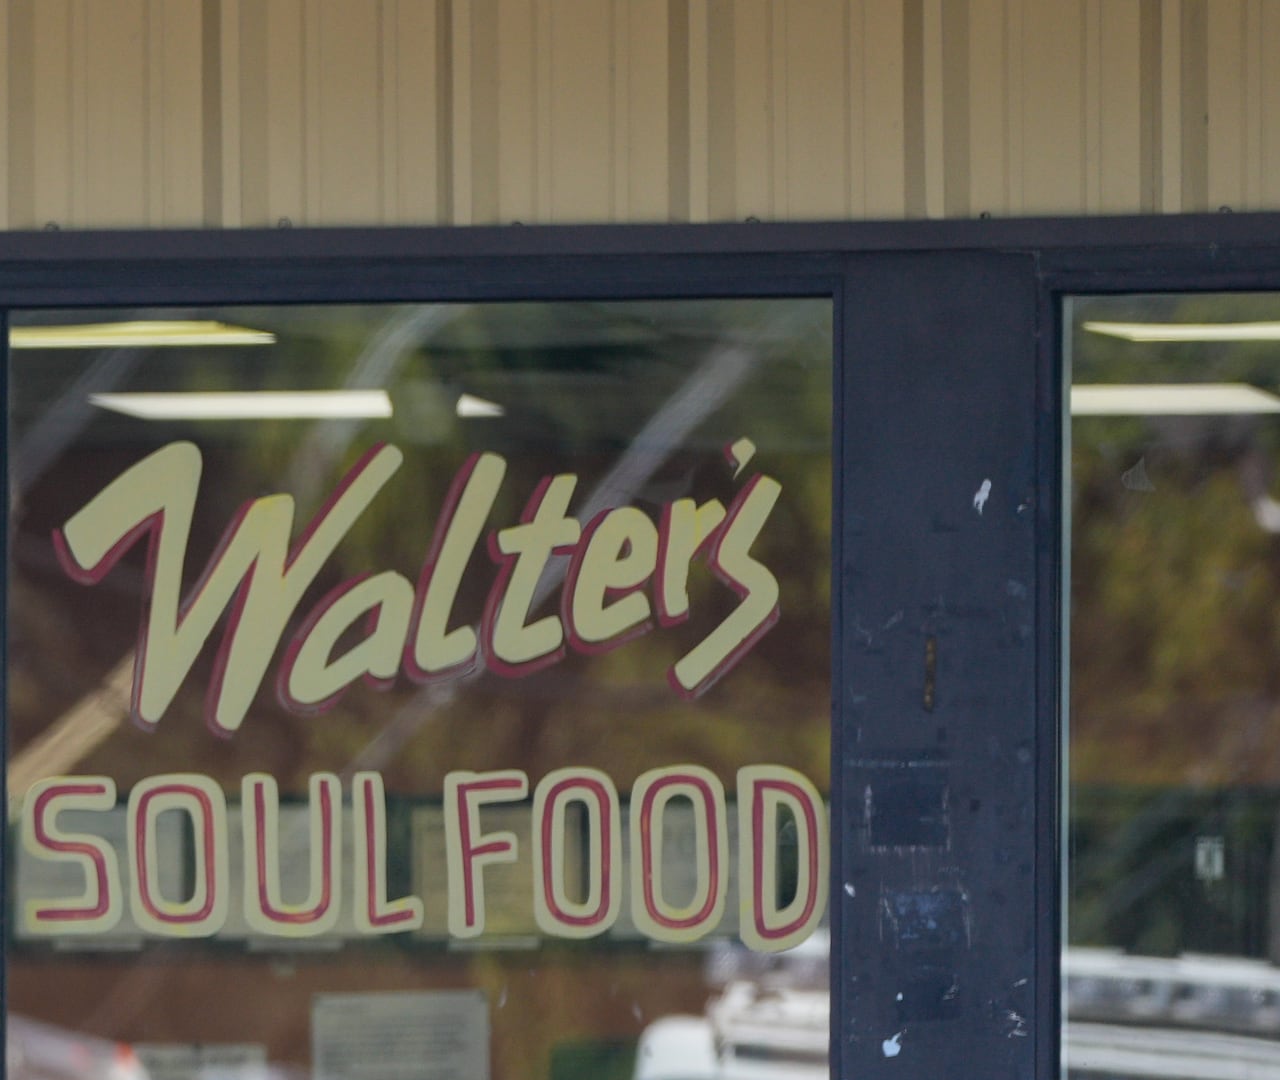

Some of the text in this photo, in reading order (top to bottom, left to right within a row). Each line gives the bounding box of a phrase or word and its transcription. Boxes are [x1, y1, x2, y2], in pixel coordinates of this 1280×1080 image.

[52, 436, 783, 737] Walter's
[22, 764, 827, 953] SOUL FOOD
